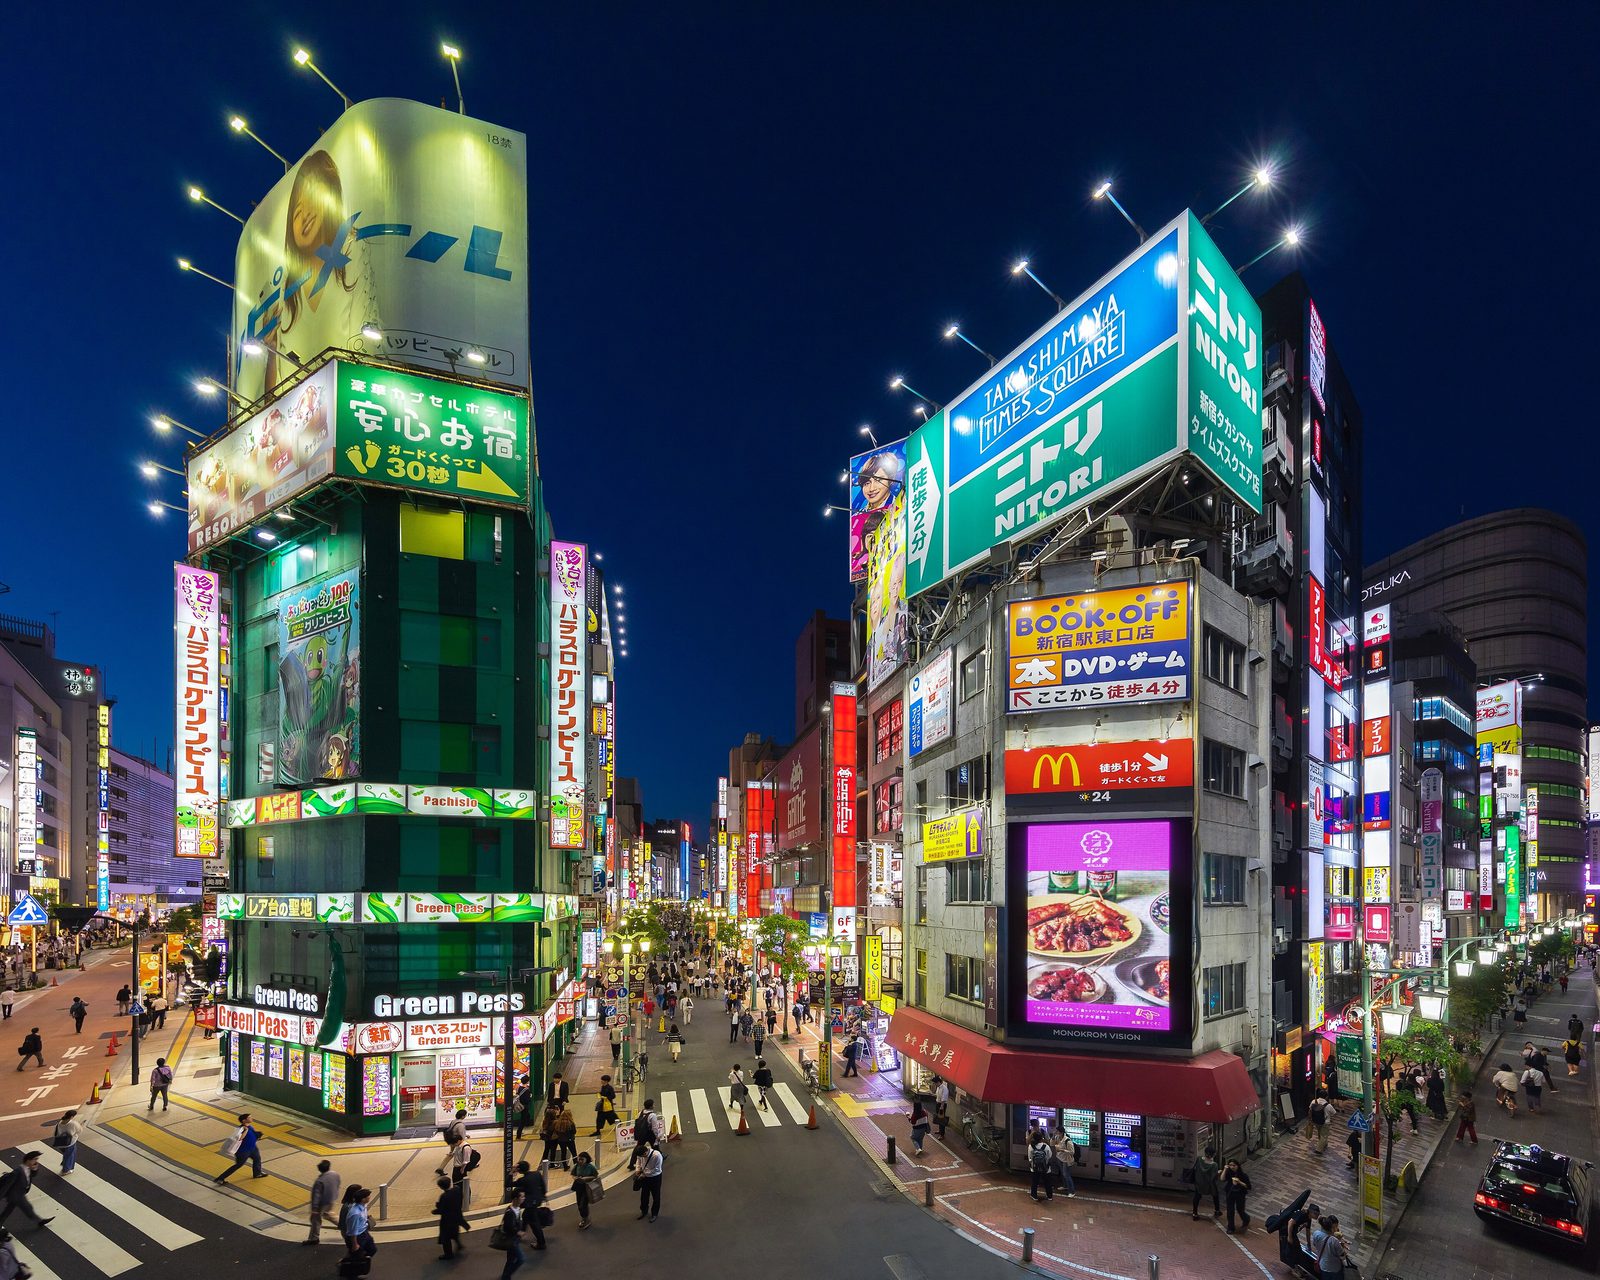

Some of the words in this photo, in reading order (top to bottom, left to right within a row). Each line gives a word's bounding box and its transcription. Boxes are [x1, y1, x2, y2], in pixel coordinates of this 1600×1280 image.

[486, 131, 513, 150] 18禁
[1195, 257, 1257, 370] ニトリ
[377, 335, 502, 367] ハッピーメル
[984, 292, 1119, 412] TAKASHIMAYA
[1195, 321, 1257, 415] NITORI
[983, 388, 1032, 443] TIMES
[1035, 326, 1120, 416] SQUARE
[351, 378, 516, 422] 豪華カプセルホテル
[349, 399, 518, 459] 安心お宿
[1199, 389, 1254, 461] 新宿タカシマヤ
[388, 444, 476, 470] ガードくぐって
[995, 400, 1103, 507] ニトリ
[1190, 414, 1260, 497] タイムズスクエア店
[386, 457, 450, 484] 30秒
[911, 466, 928, 554] 徒歩2分
[995, 456, 1103, 537] NITORI
[1036, 625, 1155, 651] 新宿駅東口店
[1015, 658, 1056, 685] 本
[1064, 651, 1186, 678] DVD・ゲーム
[1371, 719, 1383, 754] アイフル
[1099, 760, 1142, 773] 徒歩1分
[1101, 775, 1166, 786] ガードくぐって左
[423, 795, 479, 808] Pachislo
[841, 778, 852, 834] GAME
[1092, 791, 1111, 802] 24
[1373, 868, 1381, 895] おたからや
[248, 898, 314, 918] レア台の聖地
[415, 903, 452, 914] Green
[455, 902, 485, 914] Peas
[837, 916, 852, 927] 6F
[254, 984, 288, 1009] Green
[289, 988, 319, 1013] Peas
[374, 994, 456, 1017] Green
[461, 991, 526, 1014] Peas
[218, 1005, 254, 1034] Green
[257, 1011, 290, 1039] Peas
[368, 1025, 391, 1043] 新
[410, 1021, 488, 1036] 選べるスロット
[1053, 1029, 1108, 1039] MONOKROM
[1109, 1032, 1141, 1041] VISION
[418, 1035, 451, 1046] Green
[455, 1034, 481, 1045] Peas
[918, 1036, 954, 1070] 長野屋
[365, 1064, 377, 1107] ジャグラー
